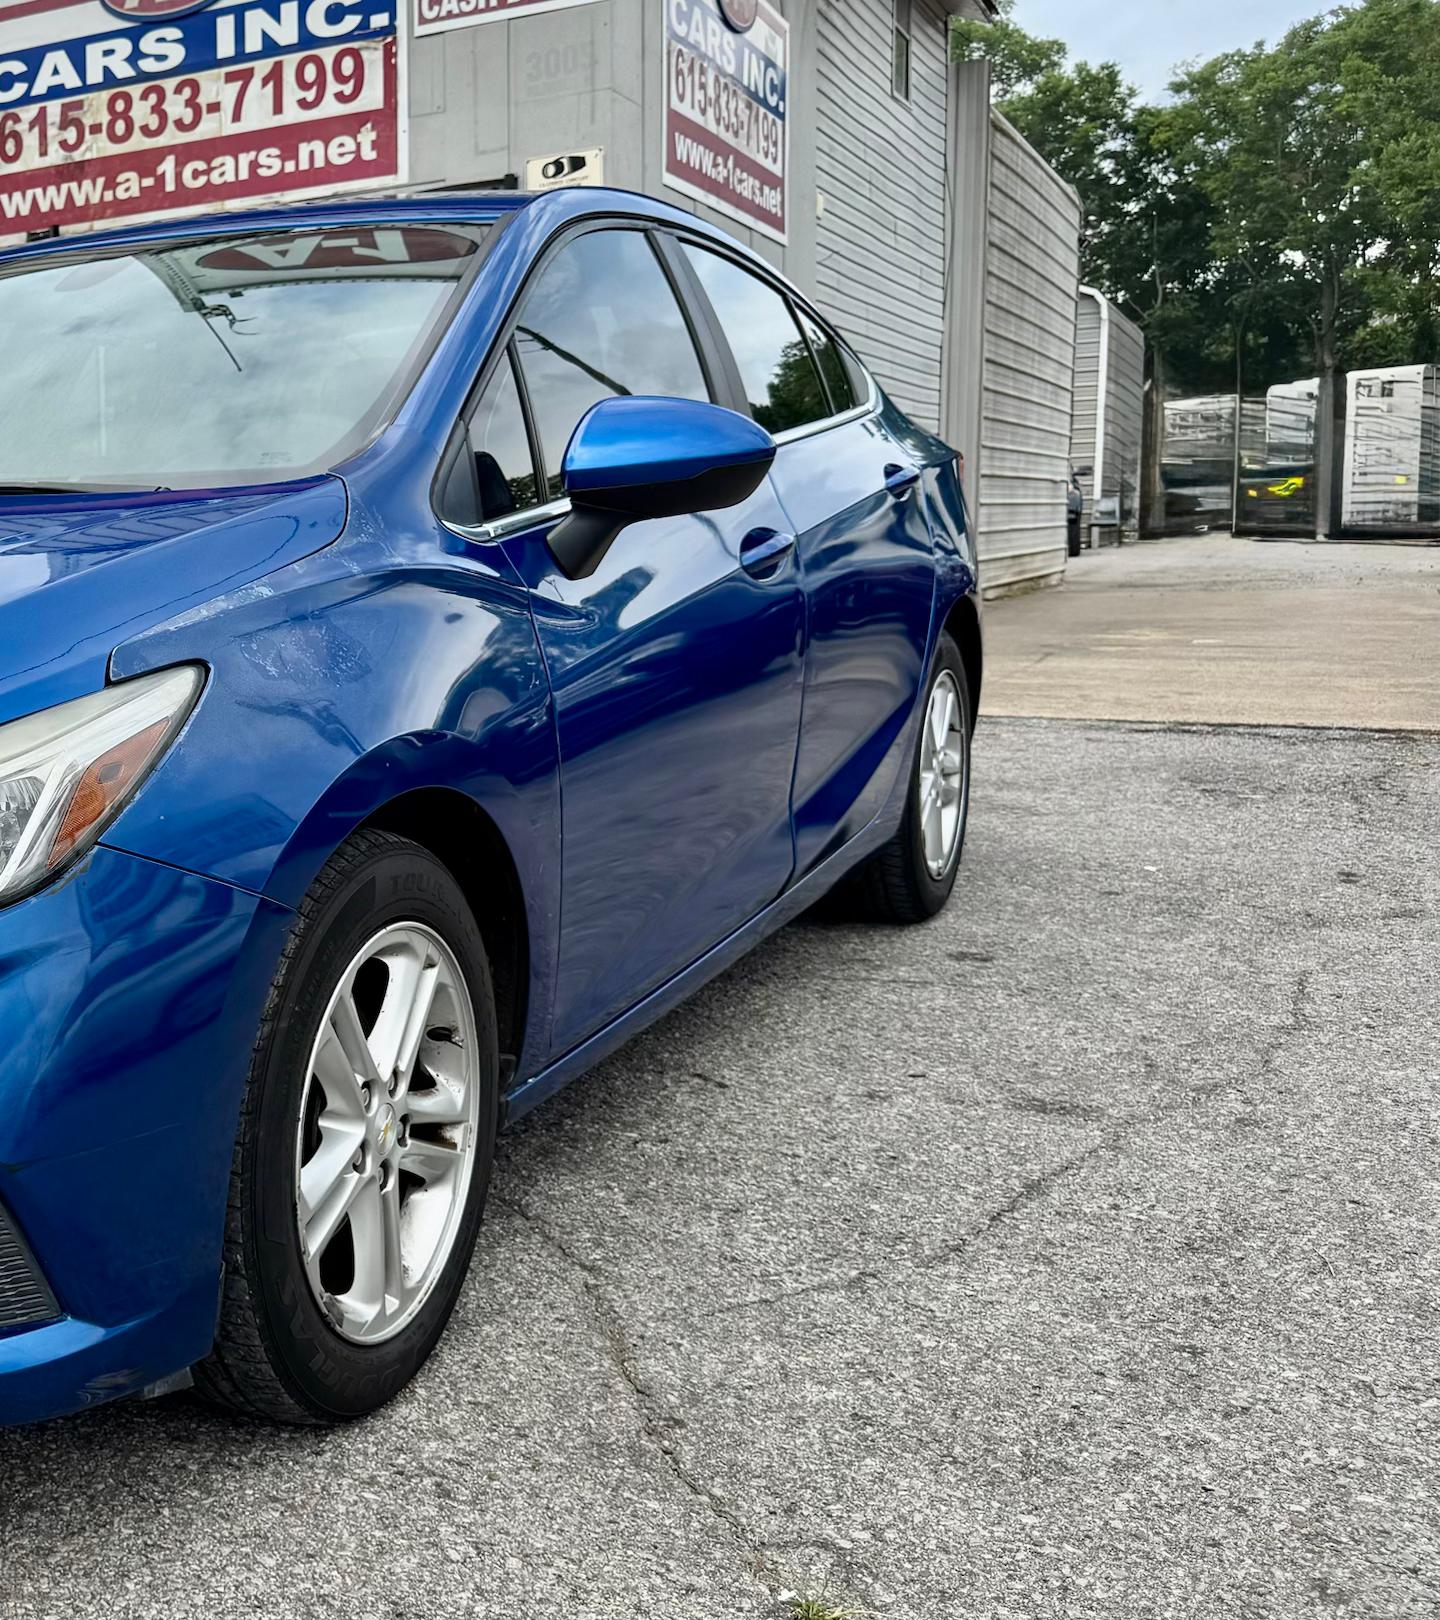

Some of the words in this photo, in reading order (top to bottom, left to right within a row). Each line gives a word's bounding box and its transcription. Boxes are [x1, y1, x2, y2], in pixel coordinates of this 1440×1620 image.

[216, 0, 391, 60] INC.
[669, 0, 736, 75] CARS
[743, 47, 785, 113] INC.
[675, 47, 778, 164] 615-833-7199
[0, 122, 378, 219] www.a-1cars.net
[674, 132, 782, 217] www.a-1cars.net
